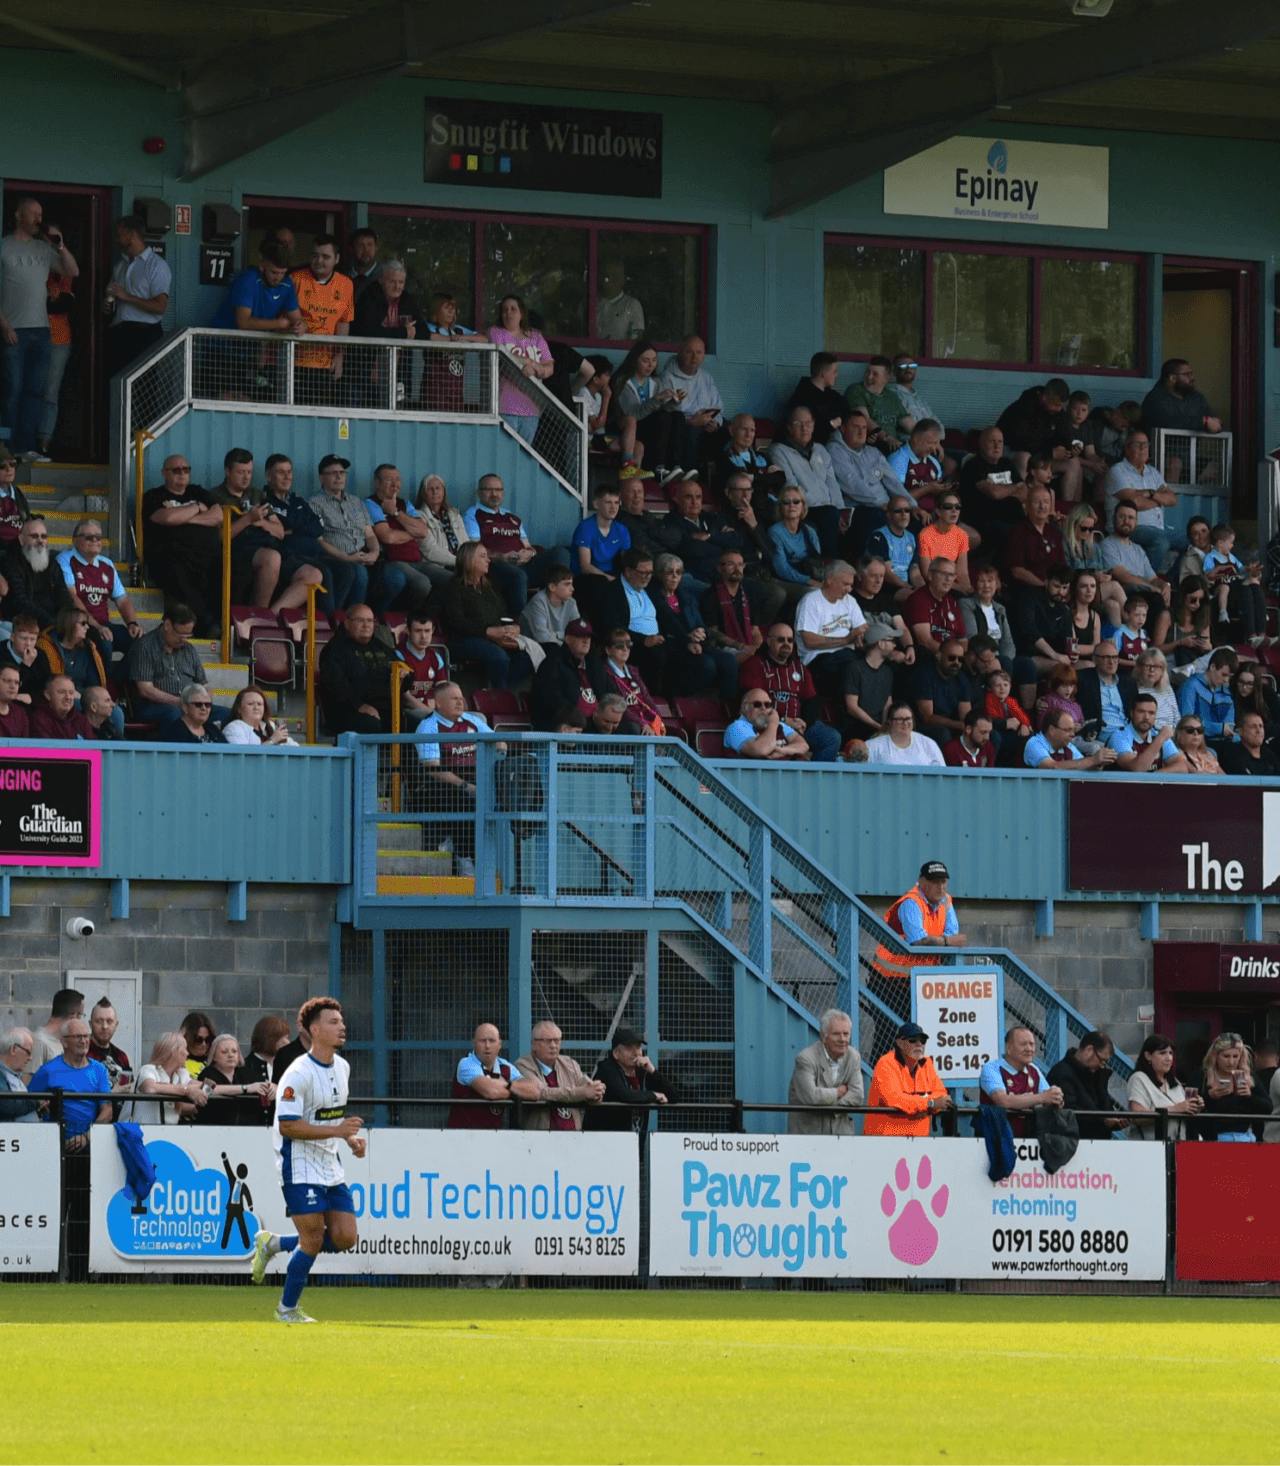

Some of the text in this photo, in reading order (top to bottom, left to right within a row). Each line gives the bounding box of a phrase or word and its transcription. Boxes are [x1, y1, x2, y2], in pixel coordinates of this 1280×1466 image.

[430, 114, 657, 159] Snugfit Windows
[956, 168, 1039, 210] Epinay
[954, 207, 980, 217] Business
[988, 209, 1018, 220] Enterprise
[1019, 210, 1039, 221] School
[210, 258, 225, 279] 11
[31, 803, 58, 821] The
[19, 815, 83, 834] Guardian
[20, 834, 83, 845] University Guide 2023
[1182, 842, 1244, 891] The
[1230, 956, 1280, 979] Drinks
[921, 981, 992, 1000] ORANGE
[939, 1007, 977, 1023] Zone
[936, 1031, 979, 1048] Seats
[683, 1137, 780, 1156] Proud to support
[682, 1160, 848, 1209] Pawz For
[149, 1180, 220, 1216] Cloud
[349, 1169, 625, 1235] oud Technology
[992, 1193, 1077, 1223] rehoming
[130, 1215, 221, 1243] Technology
[535, 1236, 564, 1256] 0191
[568, 1237, 591, 1256] 543
[596, 1237, 626, 1256] 8125
[681, 1209, 848, 1272] Thought
[992, 1228, 1129, 1254] 0191 580 8880
[992, 1258, 1129, 1275] www.pawzforthought.org
